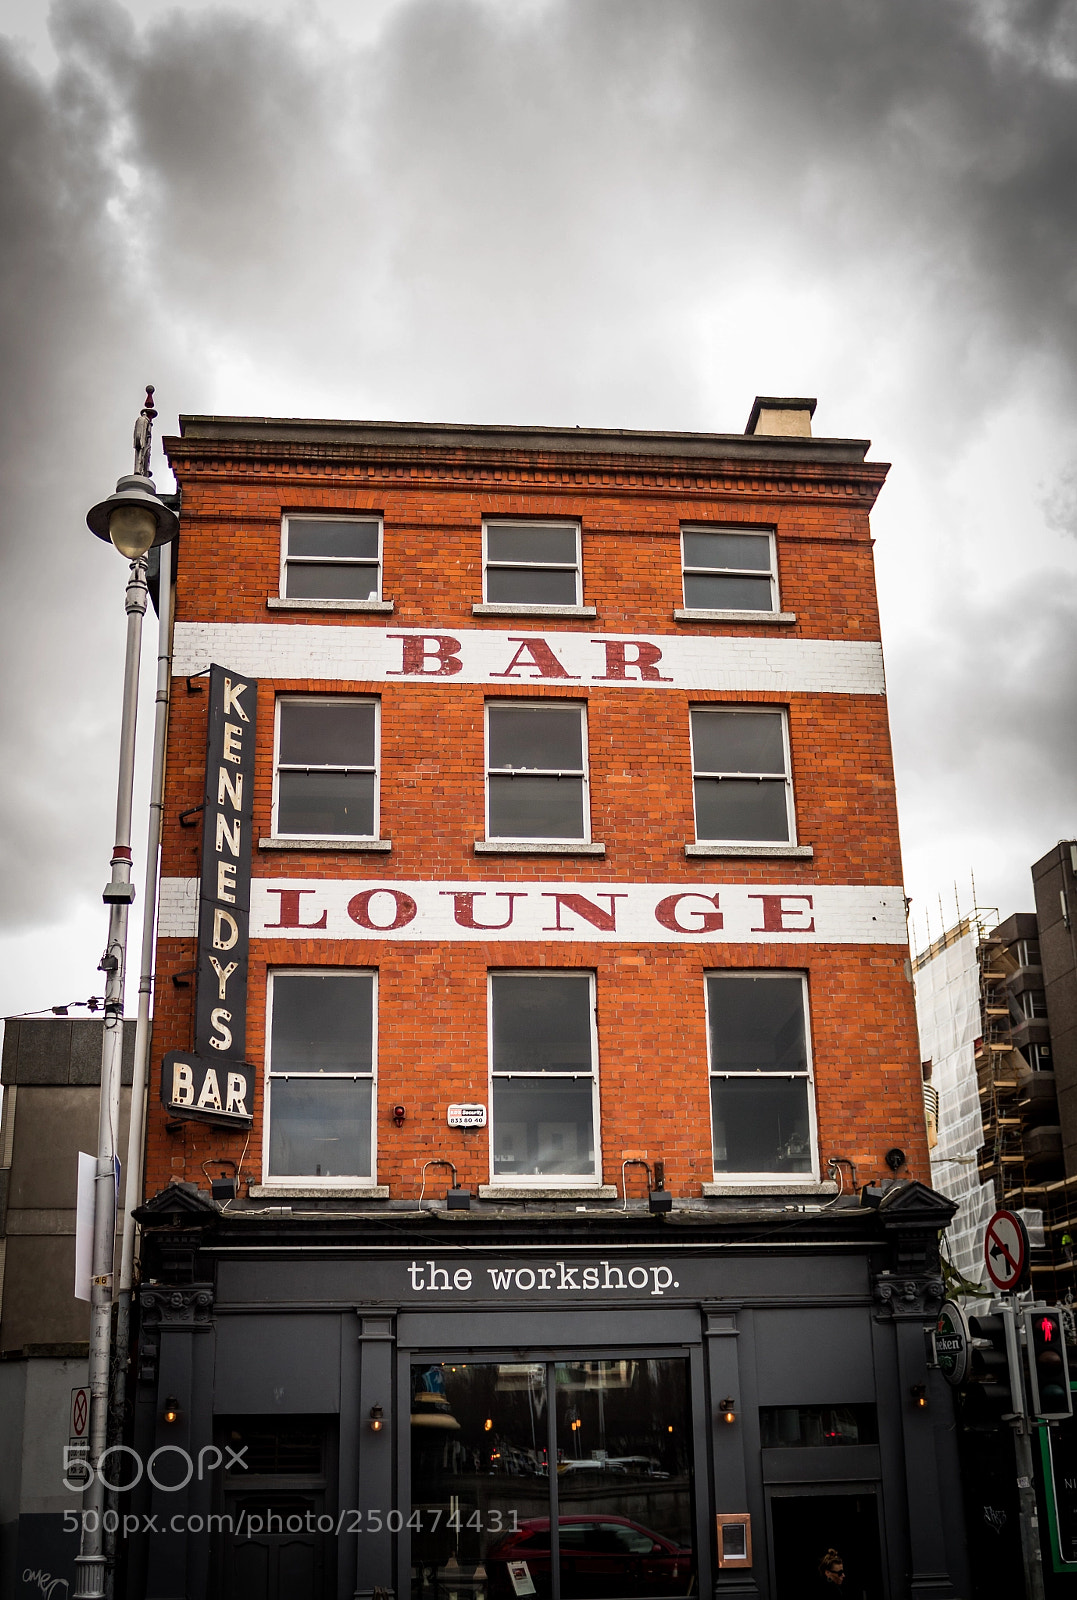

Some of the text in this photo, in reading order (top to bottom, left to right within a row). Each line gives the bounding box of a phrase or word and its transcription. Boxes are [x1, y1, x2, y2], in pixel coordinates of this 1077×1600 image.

[386, 634, 674, 682] BAR
[208, 676, 250, 1051] KENNEDYS
[264, 888, 815, 934] LOUNGE
[172, 1062, 247, 1115] BAR
[95, 1276, 107, 1285] 46
[407, 1261, 680, 1295] the workshop.
